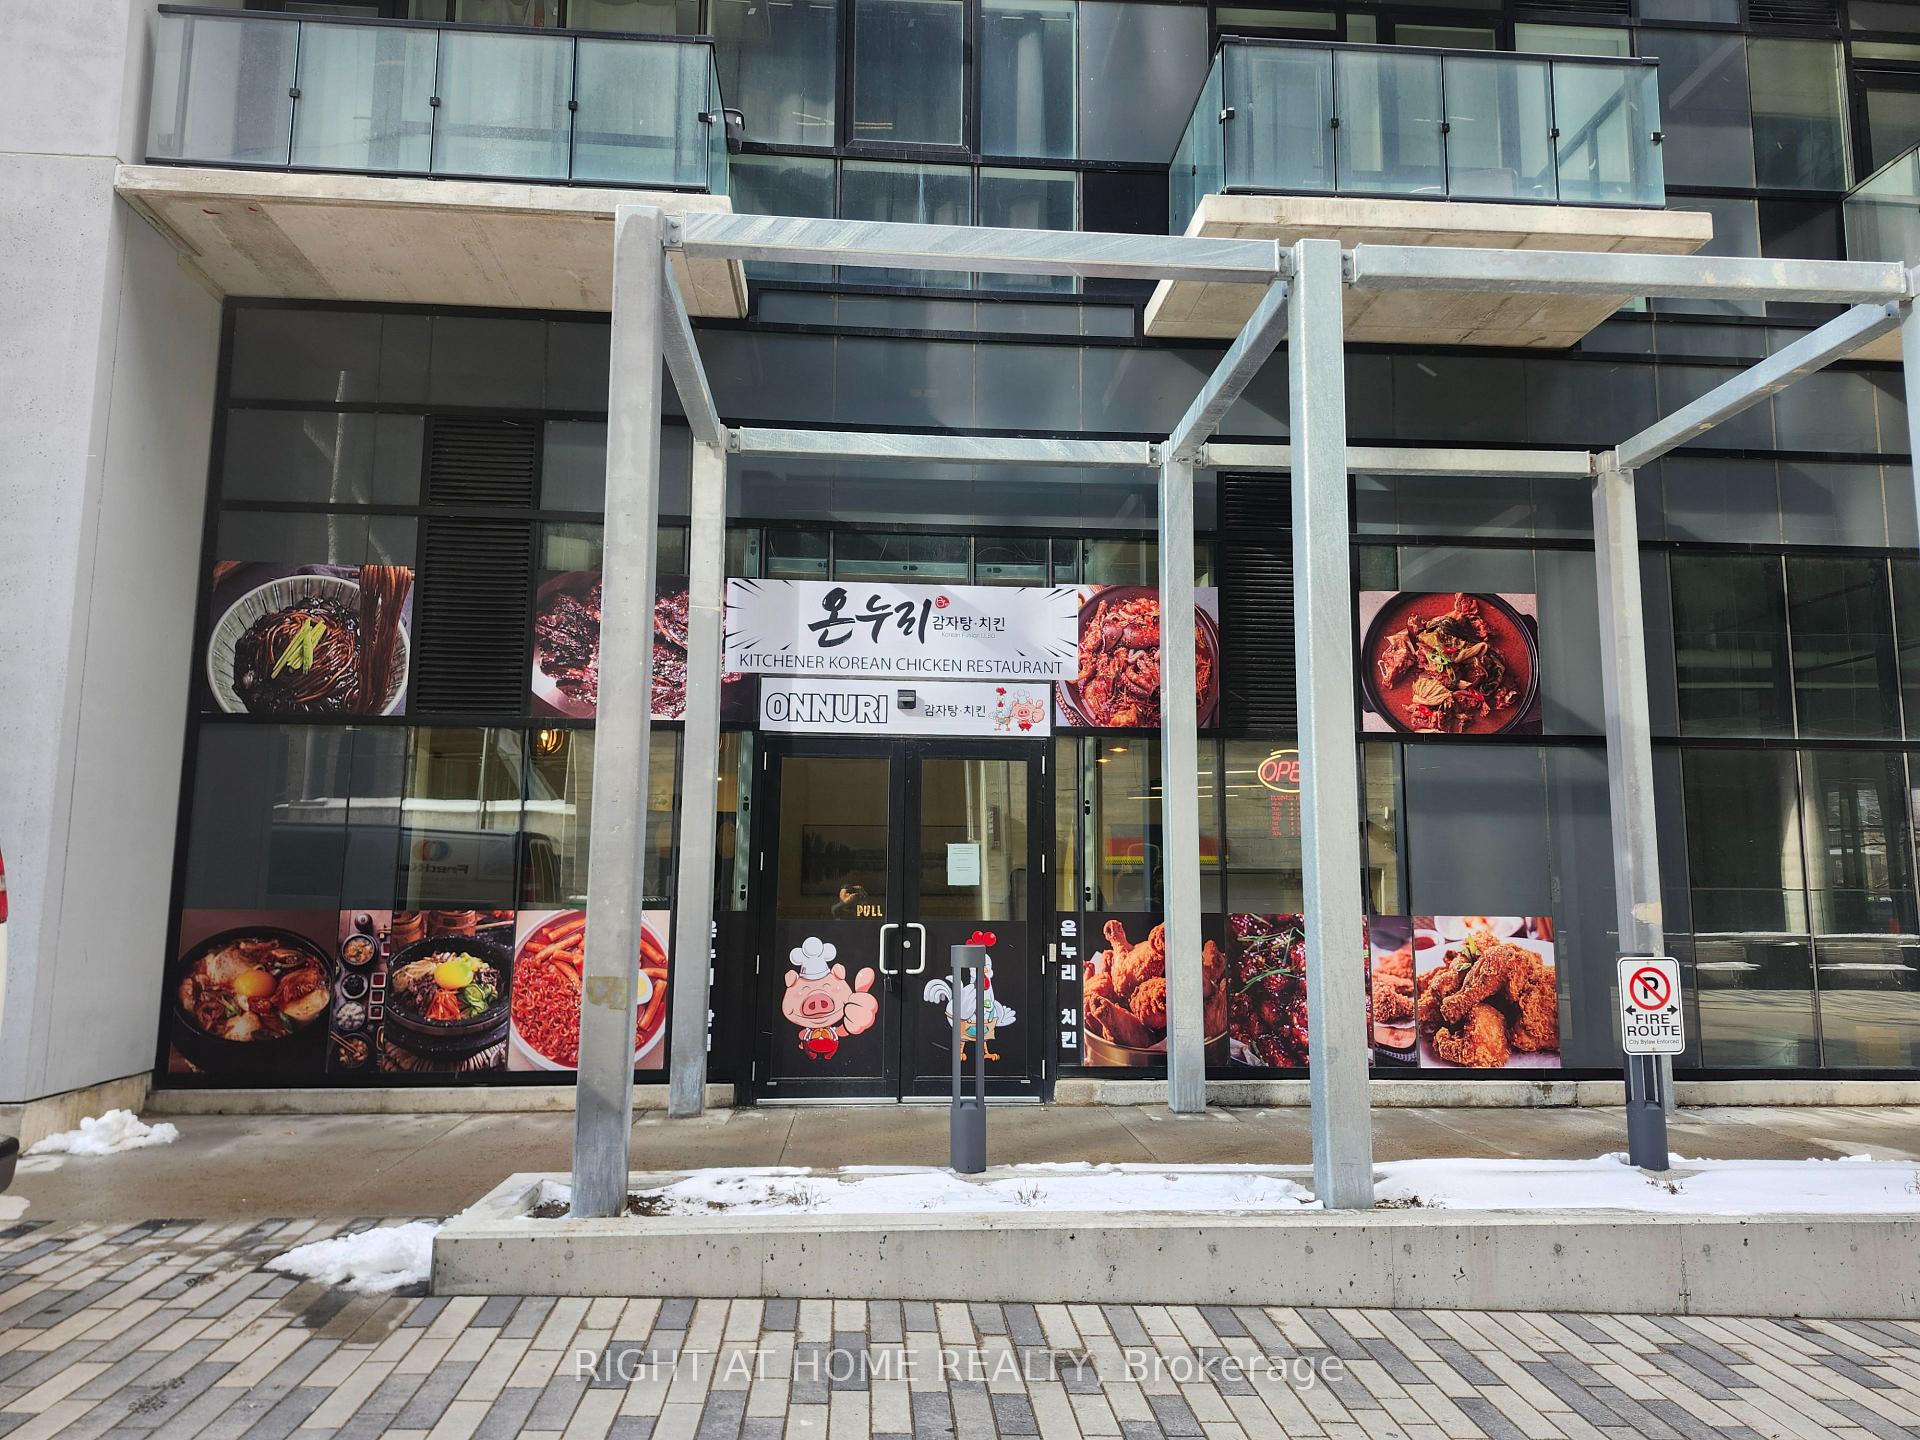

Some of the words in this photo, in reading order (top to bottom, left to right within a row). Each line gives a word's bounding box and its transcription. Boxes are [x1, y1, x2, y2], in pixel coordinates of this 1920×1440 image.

[807, 587, 932, 647] 온누리
[739, 653, 825, 669] KITCHENER
[829, 656, 891, 671] KOREAN
[896, 657, 962, 672] CHICKEN
[967, 659, 1063, 674] RESTAURANT
[765, 692, 889, 724] ONNURI
[1261, 760, 1301, 783] OPE
[856, 904, 883, 917] PULL
[1060, 919, 1077, 981] 온누리
[1060, 1008, 1077, 1048] 치킨
[1636, 1014, 1670, 1024] FIRE
[1627, 1026, 1680, 1036] ROUTE
